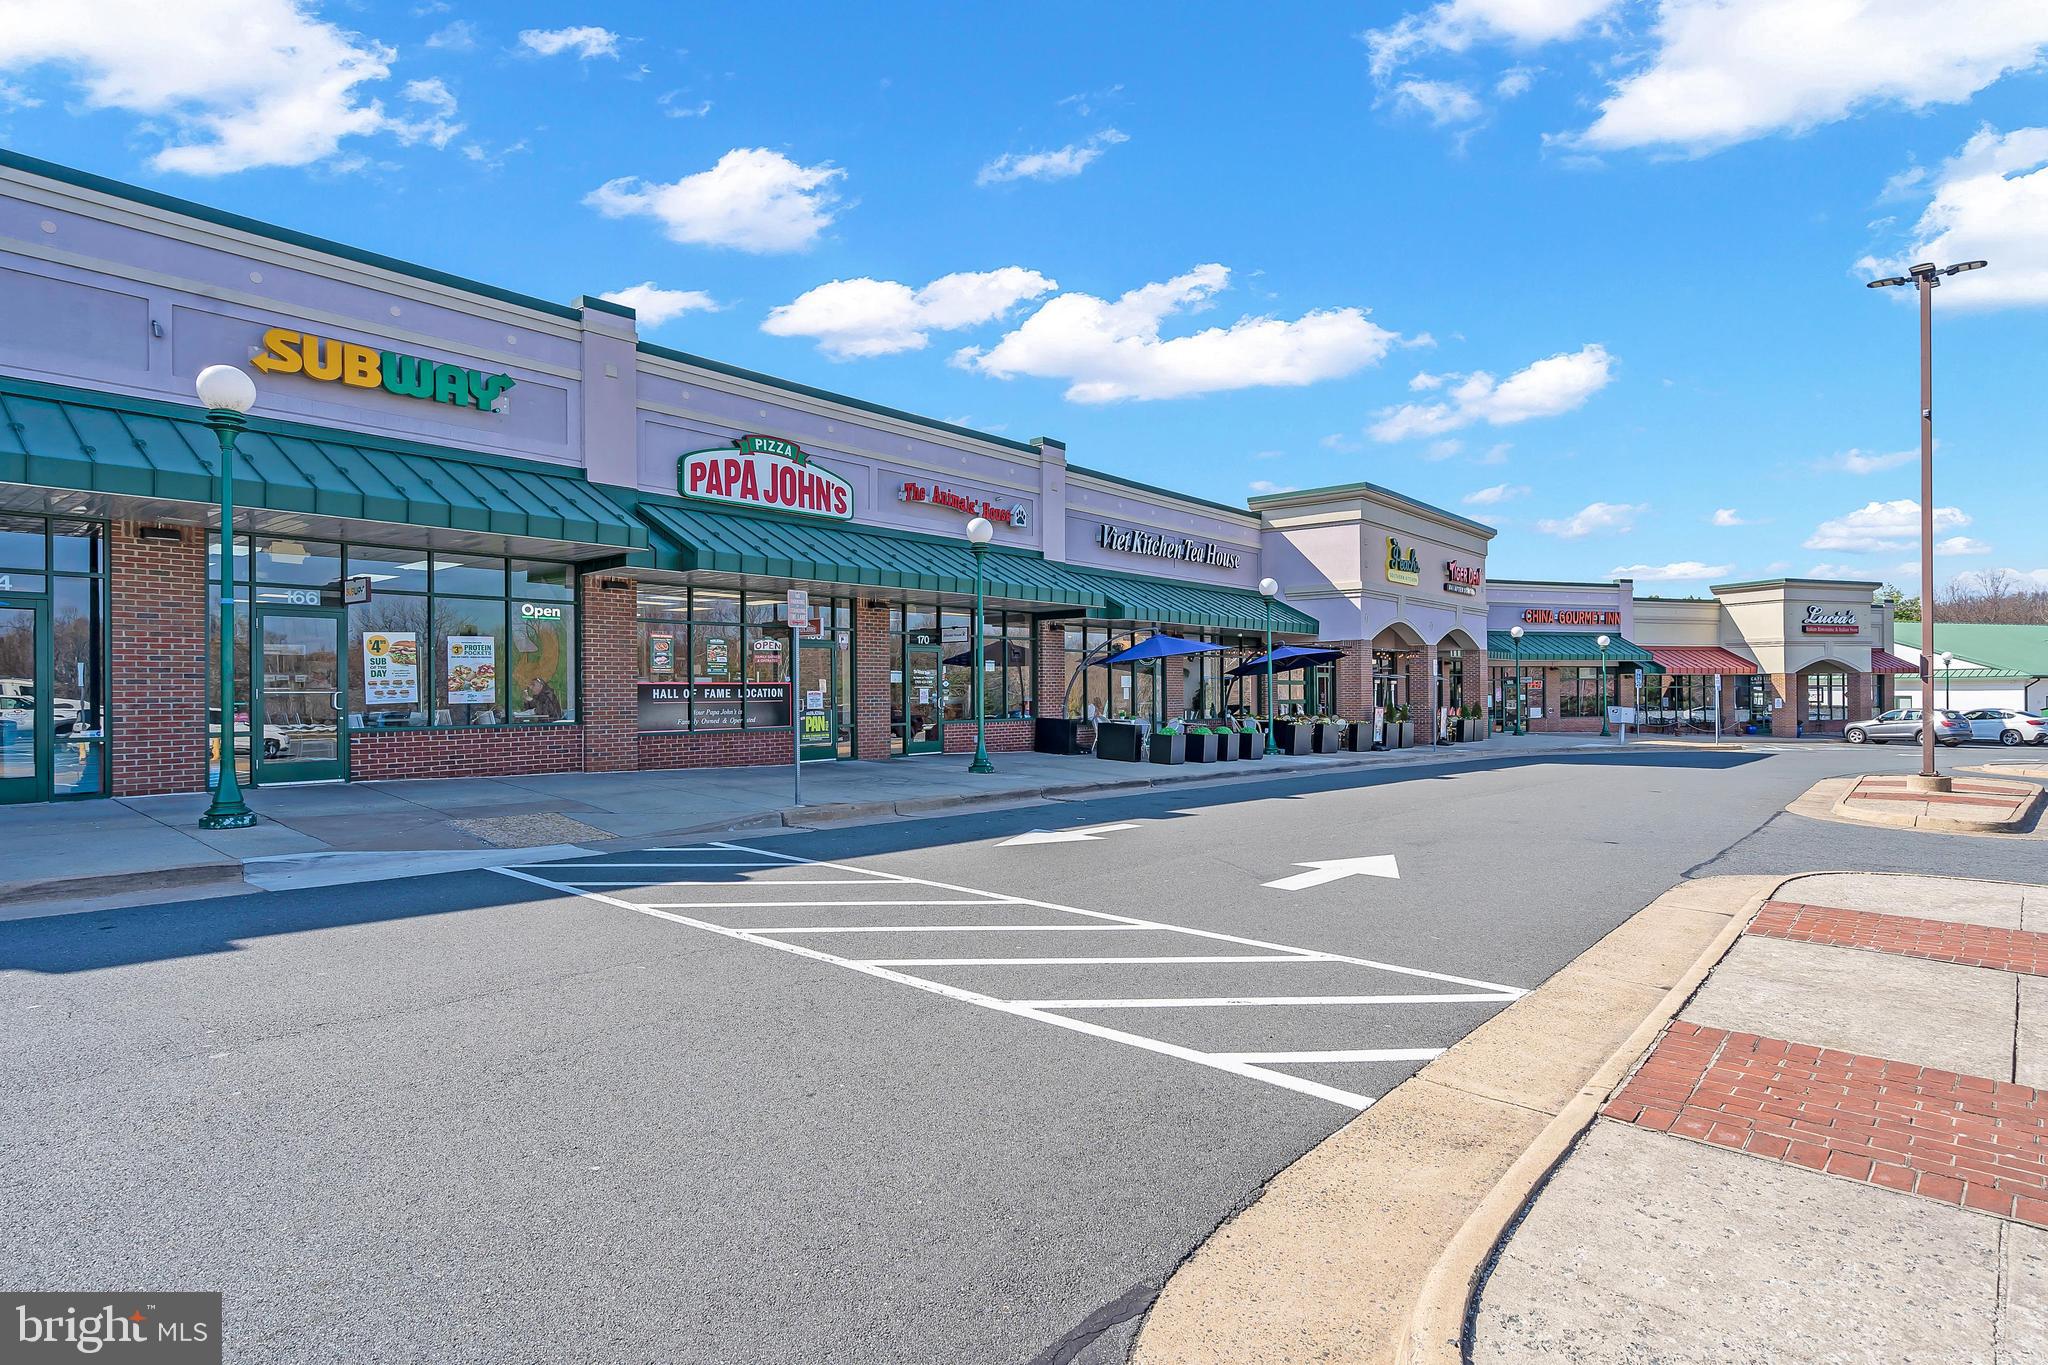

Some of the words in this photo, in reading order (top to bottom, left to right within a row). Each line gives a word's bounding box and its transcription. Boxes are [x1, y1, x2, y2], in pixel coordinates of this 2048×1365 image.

[250, 327, 516, 412] SUBWAY
[755, 438, 792, 457] PIZZA
[690, 458, 760, 501] PAPA
[763, 462, 848, 515] JOHN'S
[903, 482, 926, 501] The
[931, 485, 979, 514] Animals'
[982, 502, 1011, 522] House
[1101, 524, 1131, 551] Viet
[1132, 530, 1181, 560] Kitchen
[1183, 539, 1204, 562] Tea
[1206, 543, 1241, 569] House
[1448, 560, 1468, 583] TIGER
[1468, 567, 1482, 586] DEN
[287, 590, 318, 605] 166
[521, 603, 561, 619] Open
[1525, 609, 1554, 624] CHINA
[1558, 610, 1602, 625] GOURMET
[1604, 611, 1621, 625] INN
[1802, 605, 1857, 624] Lucia's
[755, 641, 781, 650] OPEN
[917, 635, 930, 645] 170
[370, 657, 387, 666] SUB
[370, 670, 387, 678] DAY
[653, 688, 679, 699] HALL
[704, 688, 731, 699] FAME
[737, 687, 784, 699] LOCATION
[720, 708, 737, 716] John's
[701, 717, 720, 725] Owned
[805, 715, 826, 732] PAN
